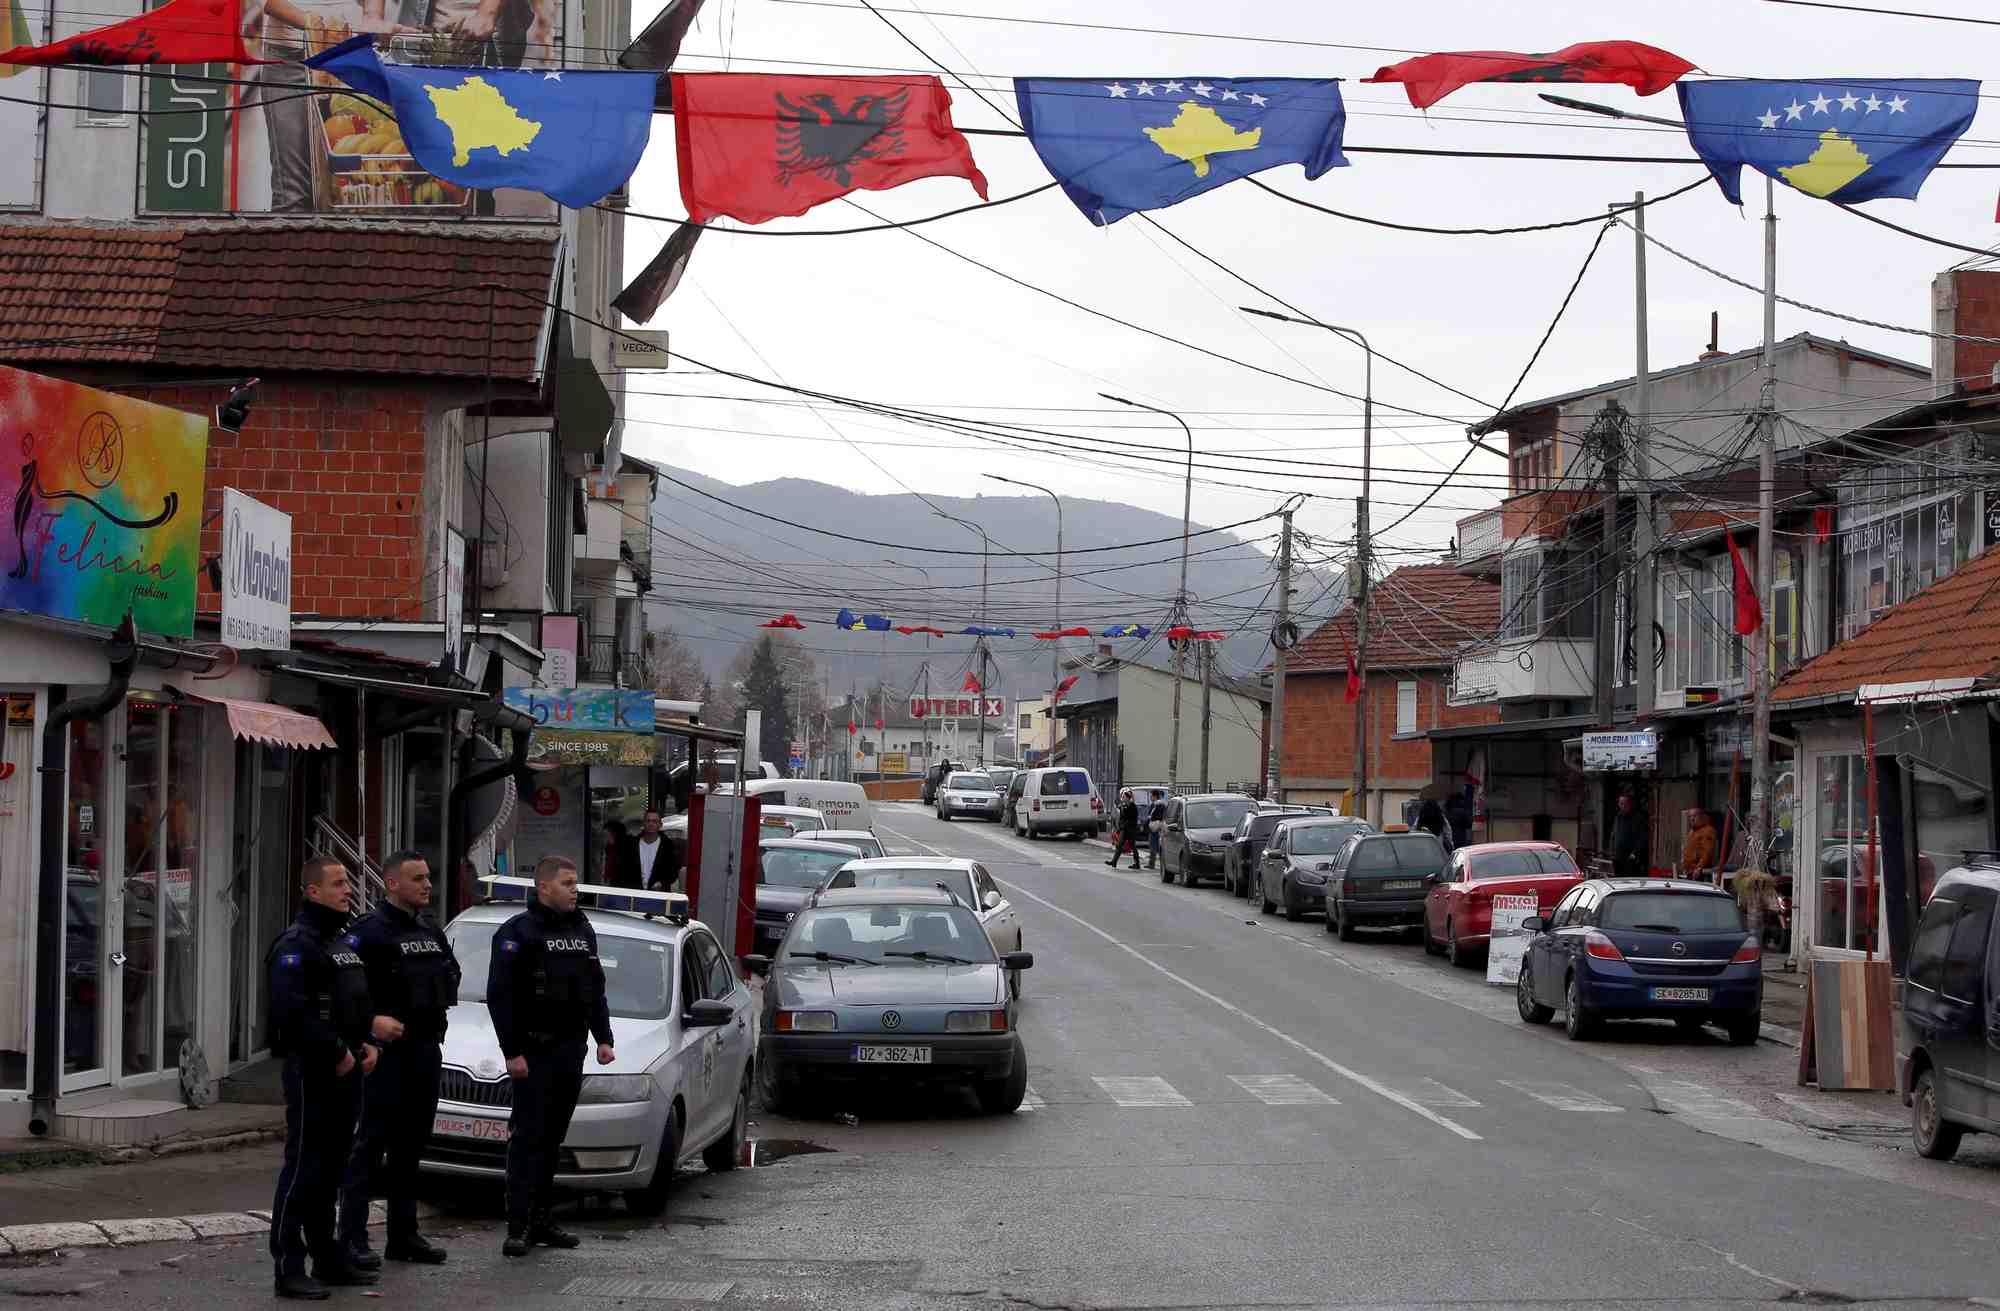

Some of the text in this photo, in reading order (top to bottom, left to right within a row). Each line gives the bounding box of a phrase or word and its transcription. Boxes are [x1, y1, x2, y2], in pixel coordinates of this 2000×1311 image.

[32, 512, 177, 586] Felicia
[1591, 735, 1629, 744] MOBILERIA
[548, 741, 609, 752] SINCE 1985
[400, 941, 442, 954] POLICE
[546, 939, 590, 951] POLICE
